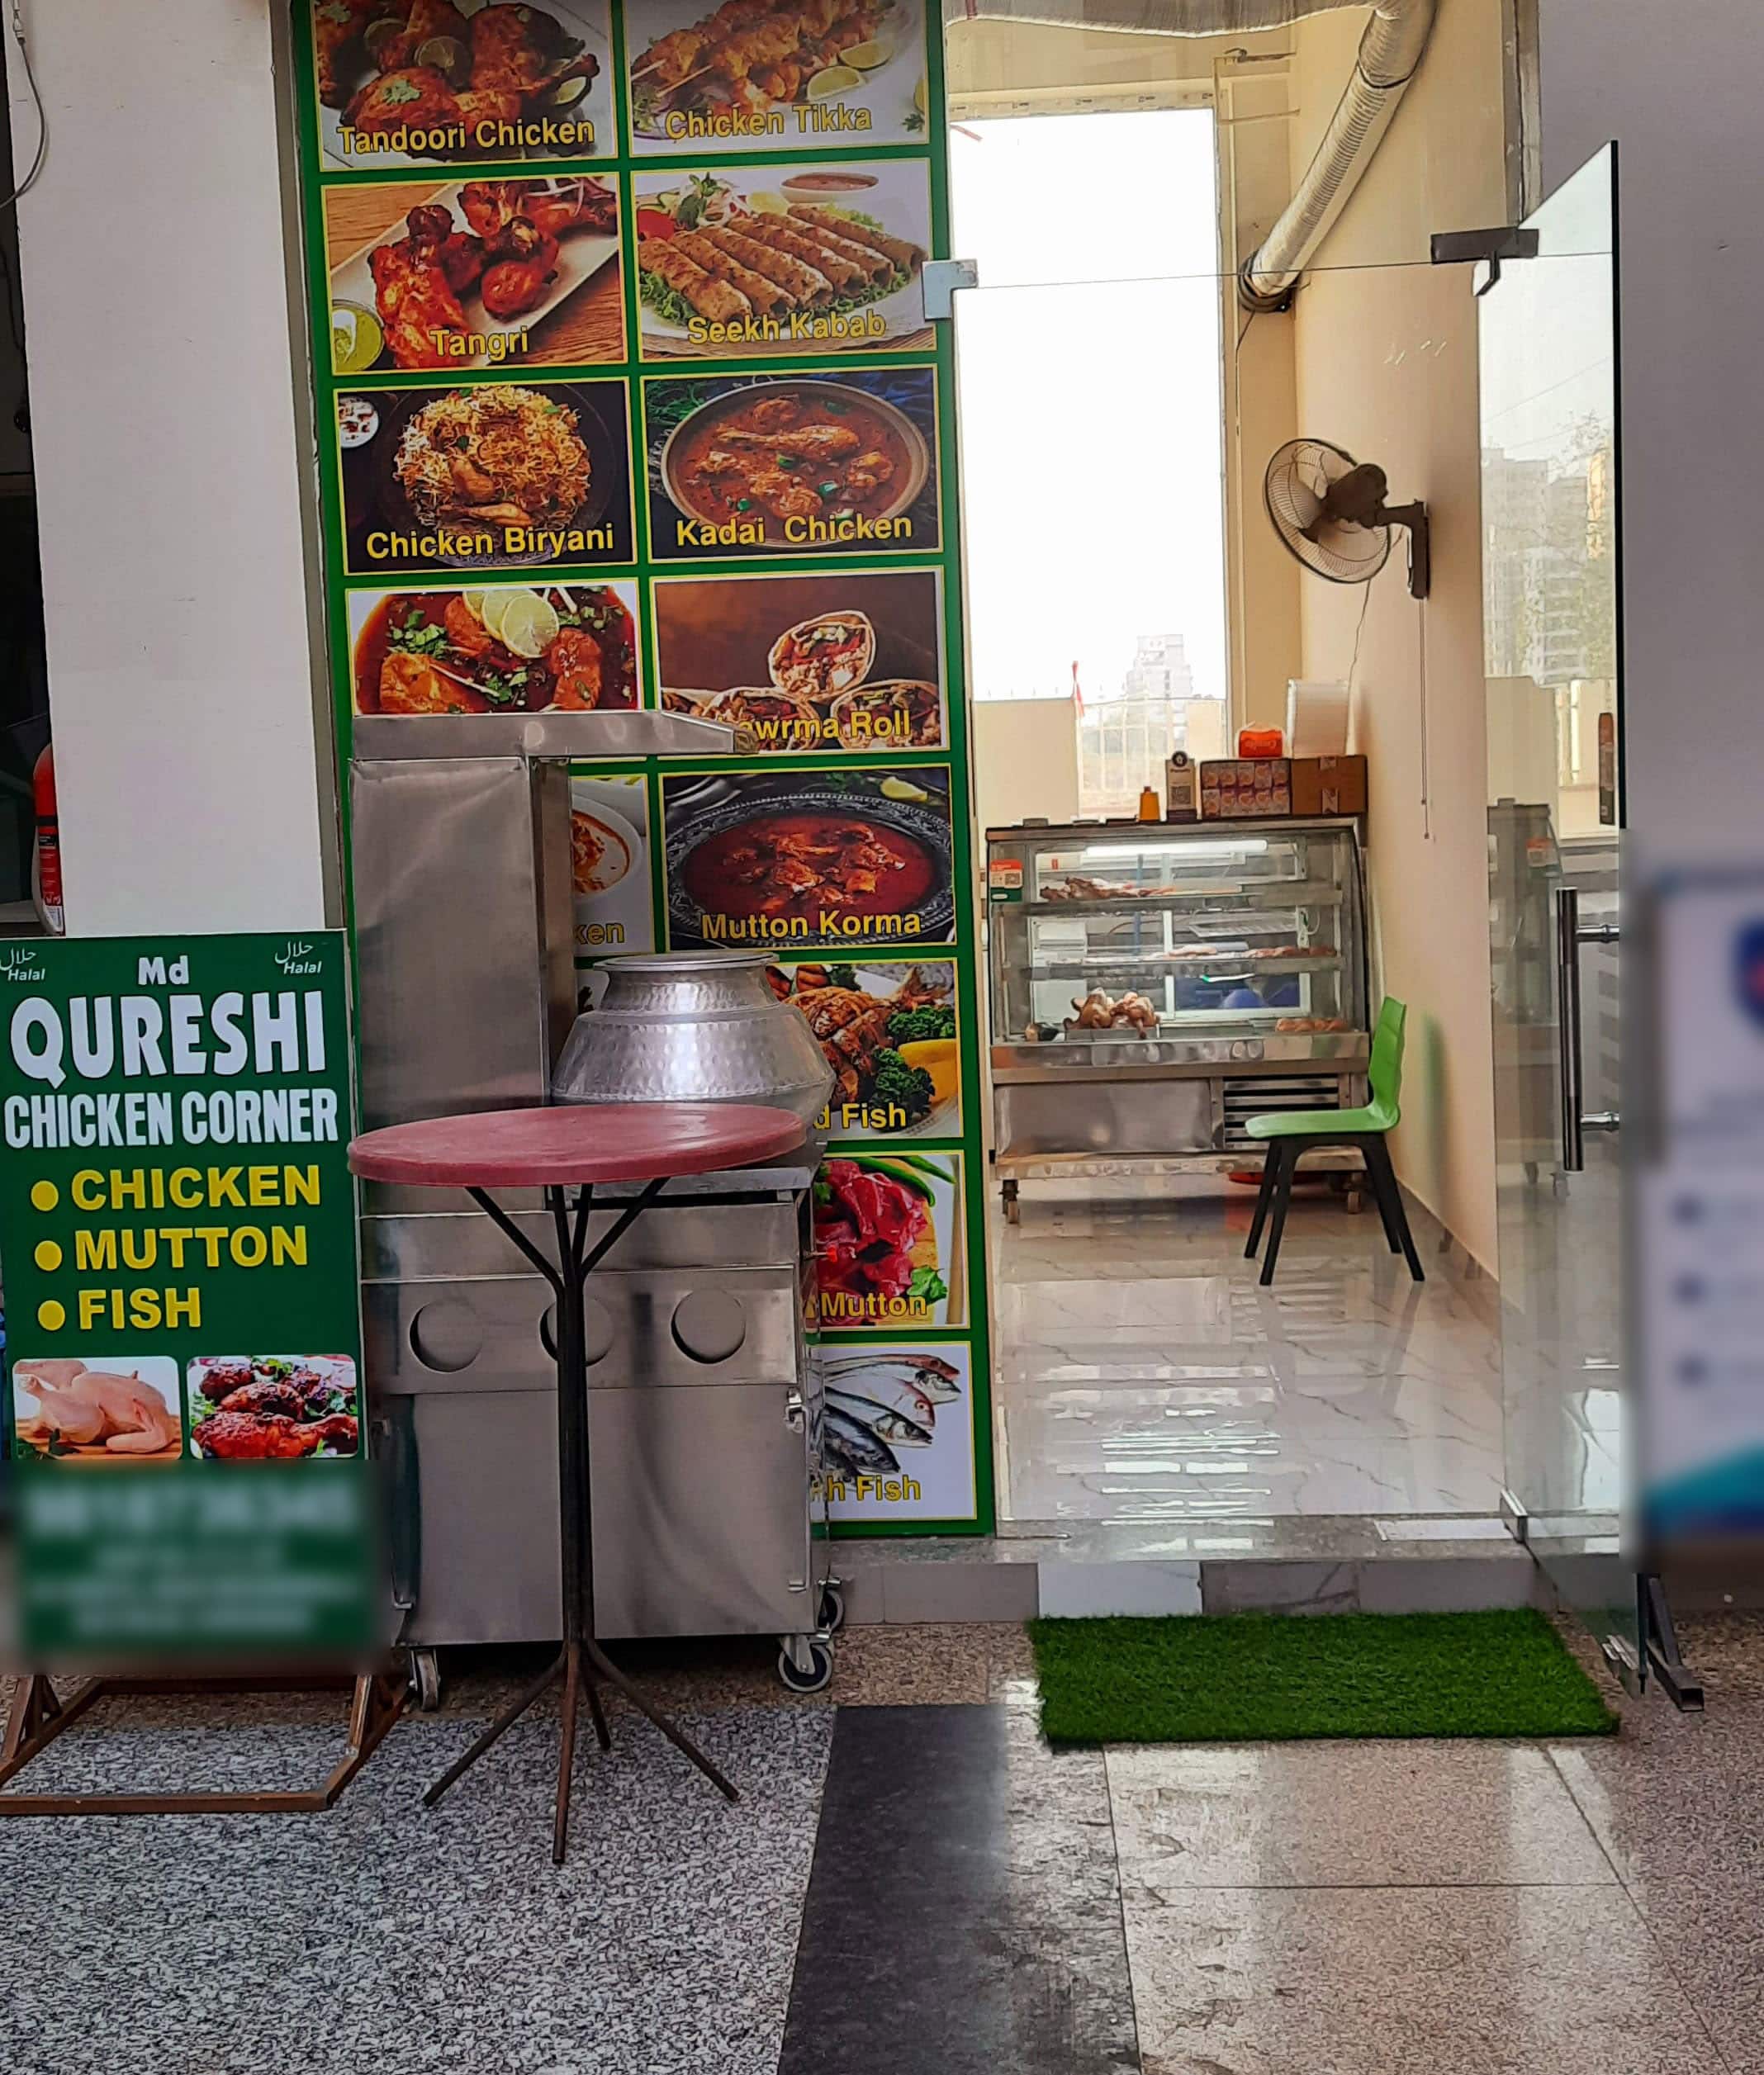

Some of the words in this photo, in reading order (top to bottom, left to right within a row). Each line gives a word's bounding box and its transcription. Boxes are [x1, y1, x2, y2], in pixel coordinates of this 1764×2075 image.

[336, 122, 467, 155] Tandoori
[475, 119, 595, 149] Chicken
[664, 108, 785, 141] Chicken
[791, 103, 873, 132] Tikka
[431, 328, 529, 358] Tangri
[688, 317, 782, 347] Seekh
[791, 310, 887, 341] Kabab
[366, 528, 495, 561] Chicken
[503, 521, 616, 558] Biryani
[675, 518, 766, 547] Kadai
[783, 512, 914, 542] Chicken
[850, 709, 913, 739] Roll
[699, 912, 809, 940] Mutton
[818, 909, 922, 936] Korma
[7, 967, 46, 982] Halal
[138, 955, 189, 987] Md
[283, 960, 323, 975] Halal
[10, 990, 326, 1089] QURESHI
[3, 1092, 174, 1149] CHICKEN
[180, 1087, 339, 1145] CORNER
[841, 1101, 908, 1130] Fish
[71, 1164, 322, 1210] CHICKEN
[74, 1225, 309, 1272] MUTTON
[78, 1286, 202, 1330] FISH
[819, 1291, 928, 1318] Mutton
[856, 1473, 922, 1502] Fish
